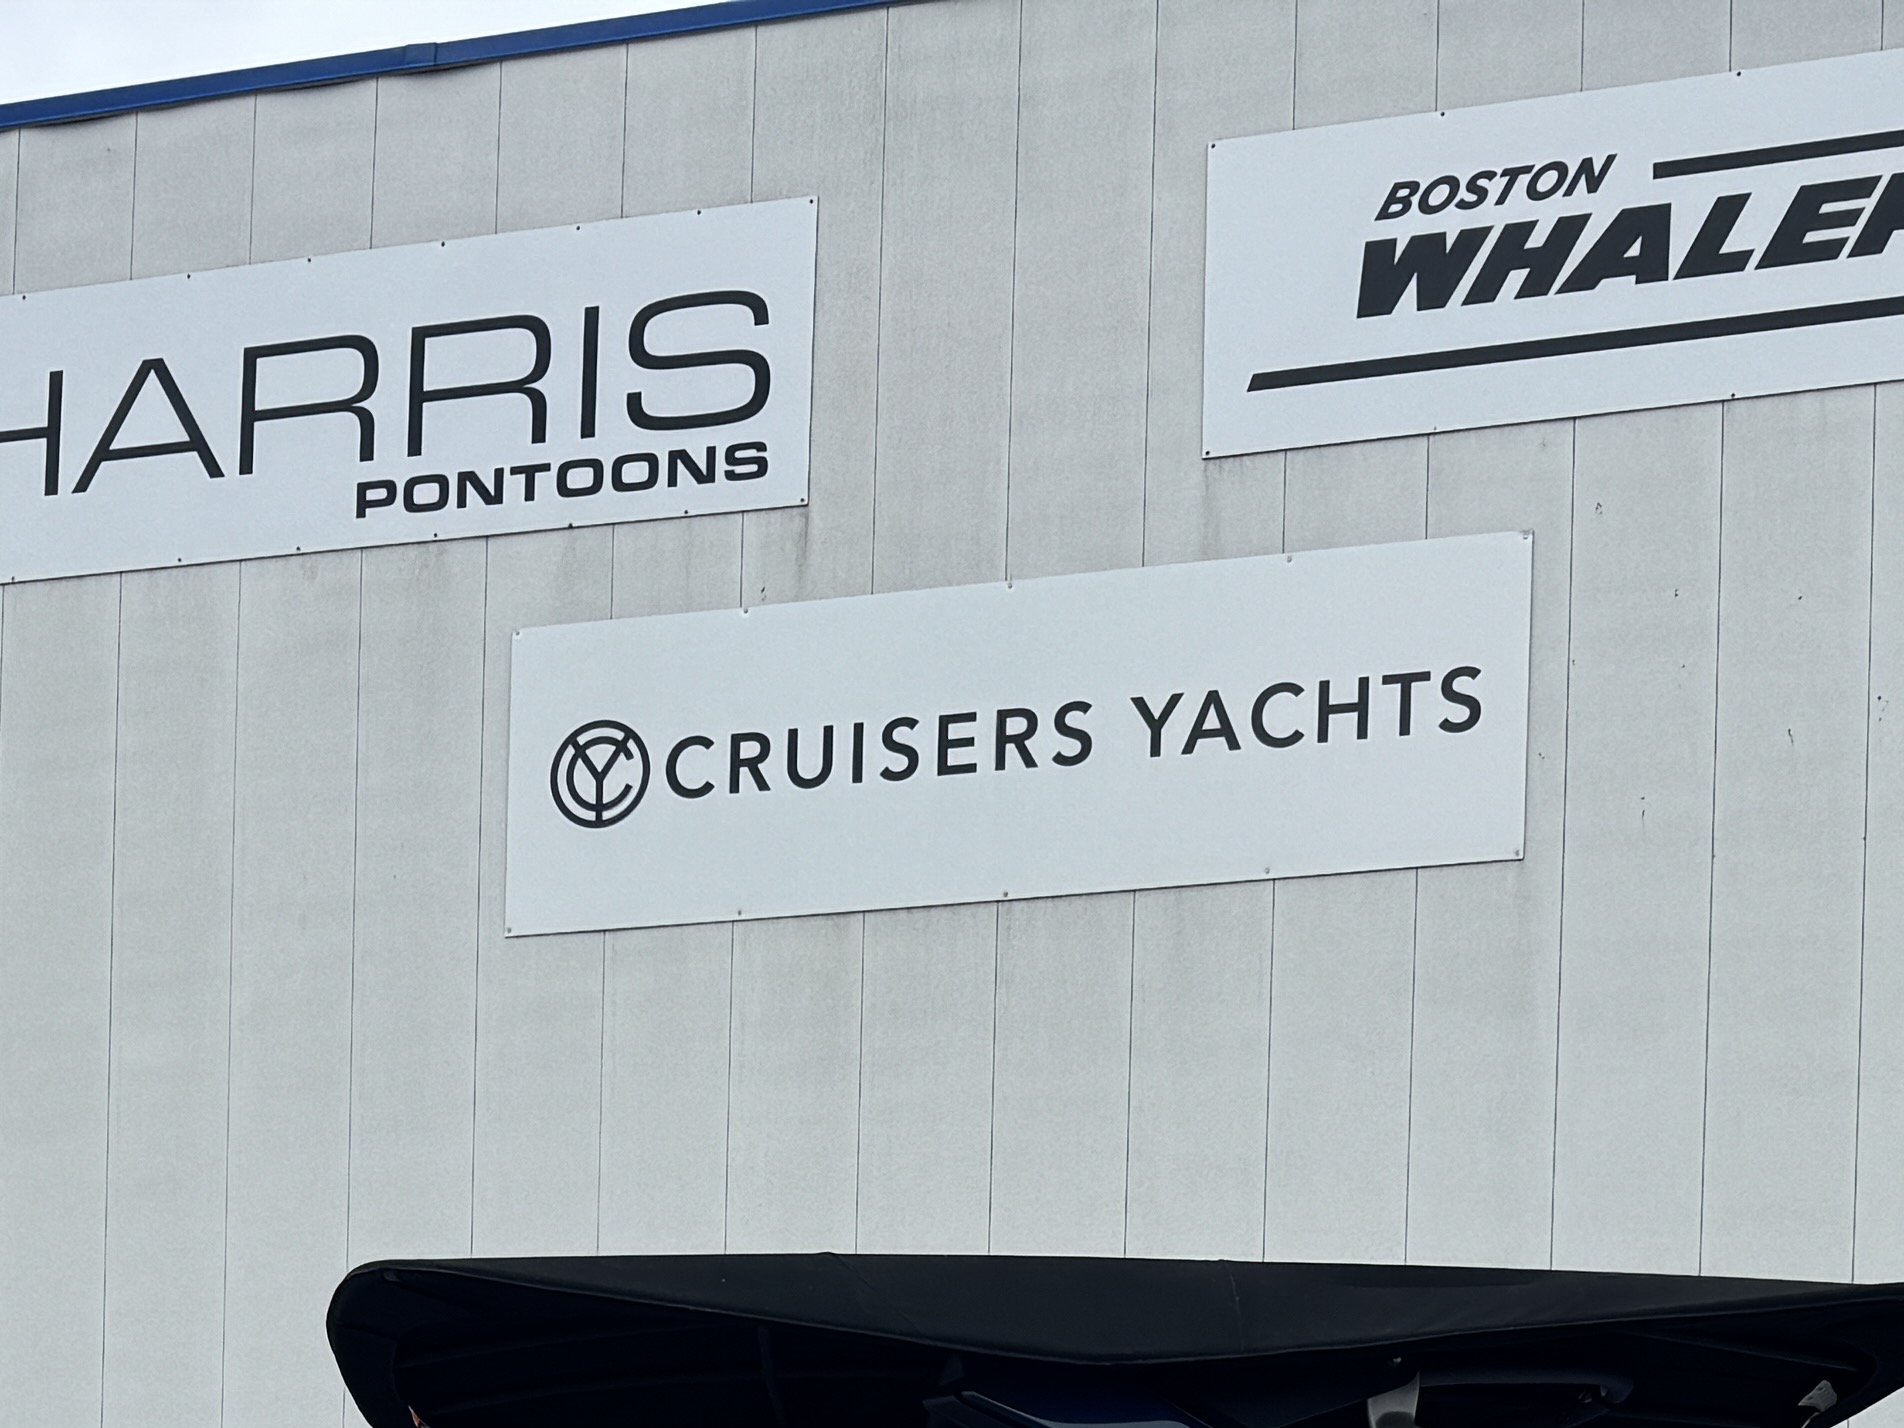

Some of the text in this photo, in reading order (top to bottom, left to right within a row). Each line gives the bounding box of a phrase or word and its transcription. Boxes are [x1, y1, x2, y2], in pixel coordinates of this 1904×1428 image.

[1374, 153, 1618, 222] BOSTON
[355, 441, 769, 519] PONTOONS
[665, 665, 1482, 799] CRUISERS YACHTS
